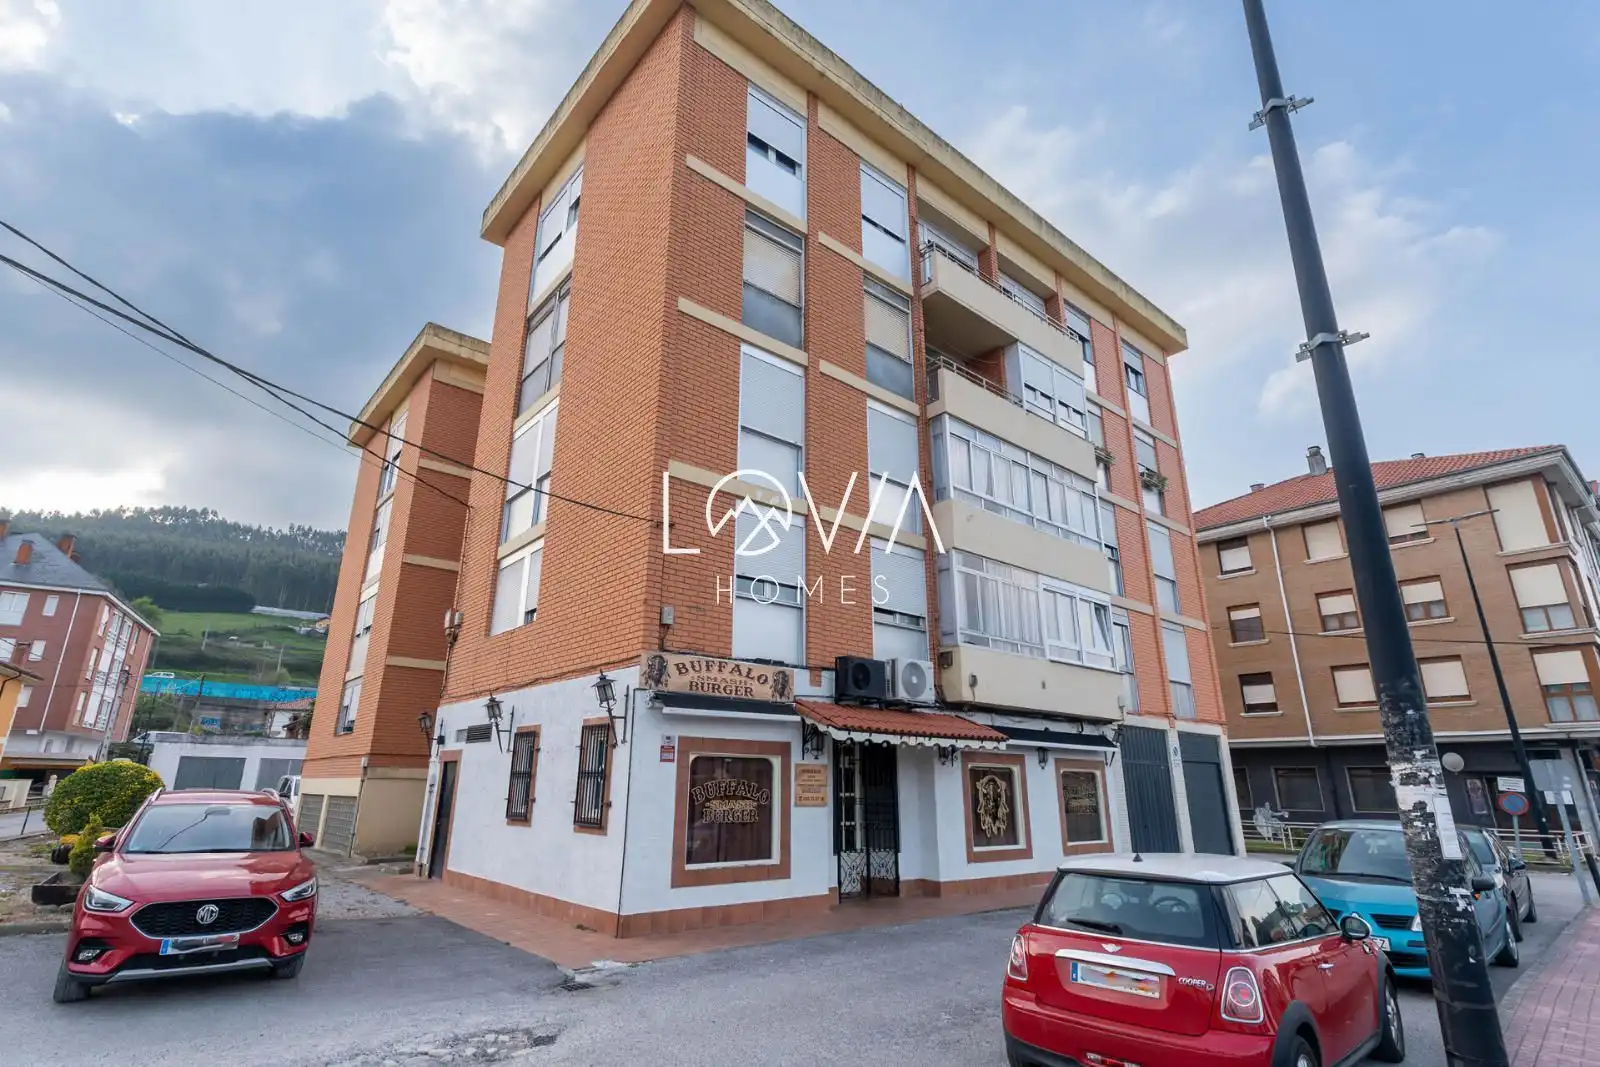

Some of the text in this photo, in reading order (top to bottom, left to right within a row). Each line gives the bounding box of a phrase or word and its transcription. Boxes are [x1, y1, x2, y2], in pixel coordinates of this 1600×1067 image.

[674, 660, 768, 684] BUFFALO
[689, 681, 754, 697] BURGER
[691, 779, 770, 805] BUFFALO
[703, 809, 758, 823] BURGER
[199, 905, 217, 922] MG
[1178, 977, 1207, 987] COOPER
